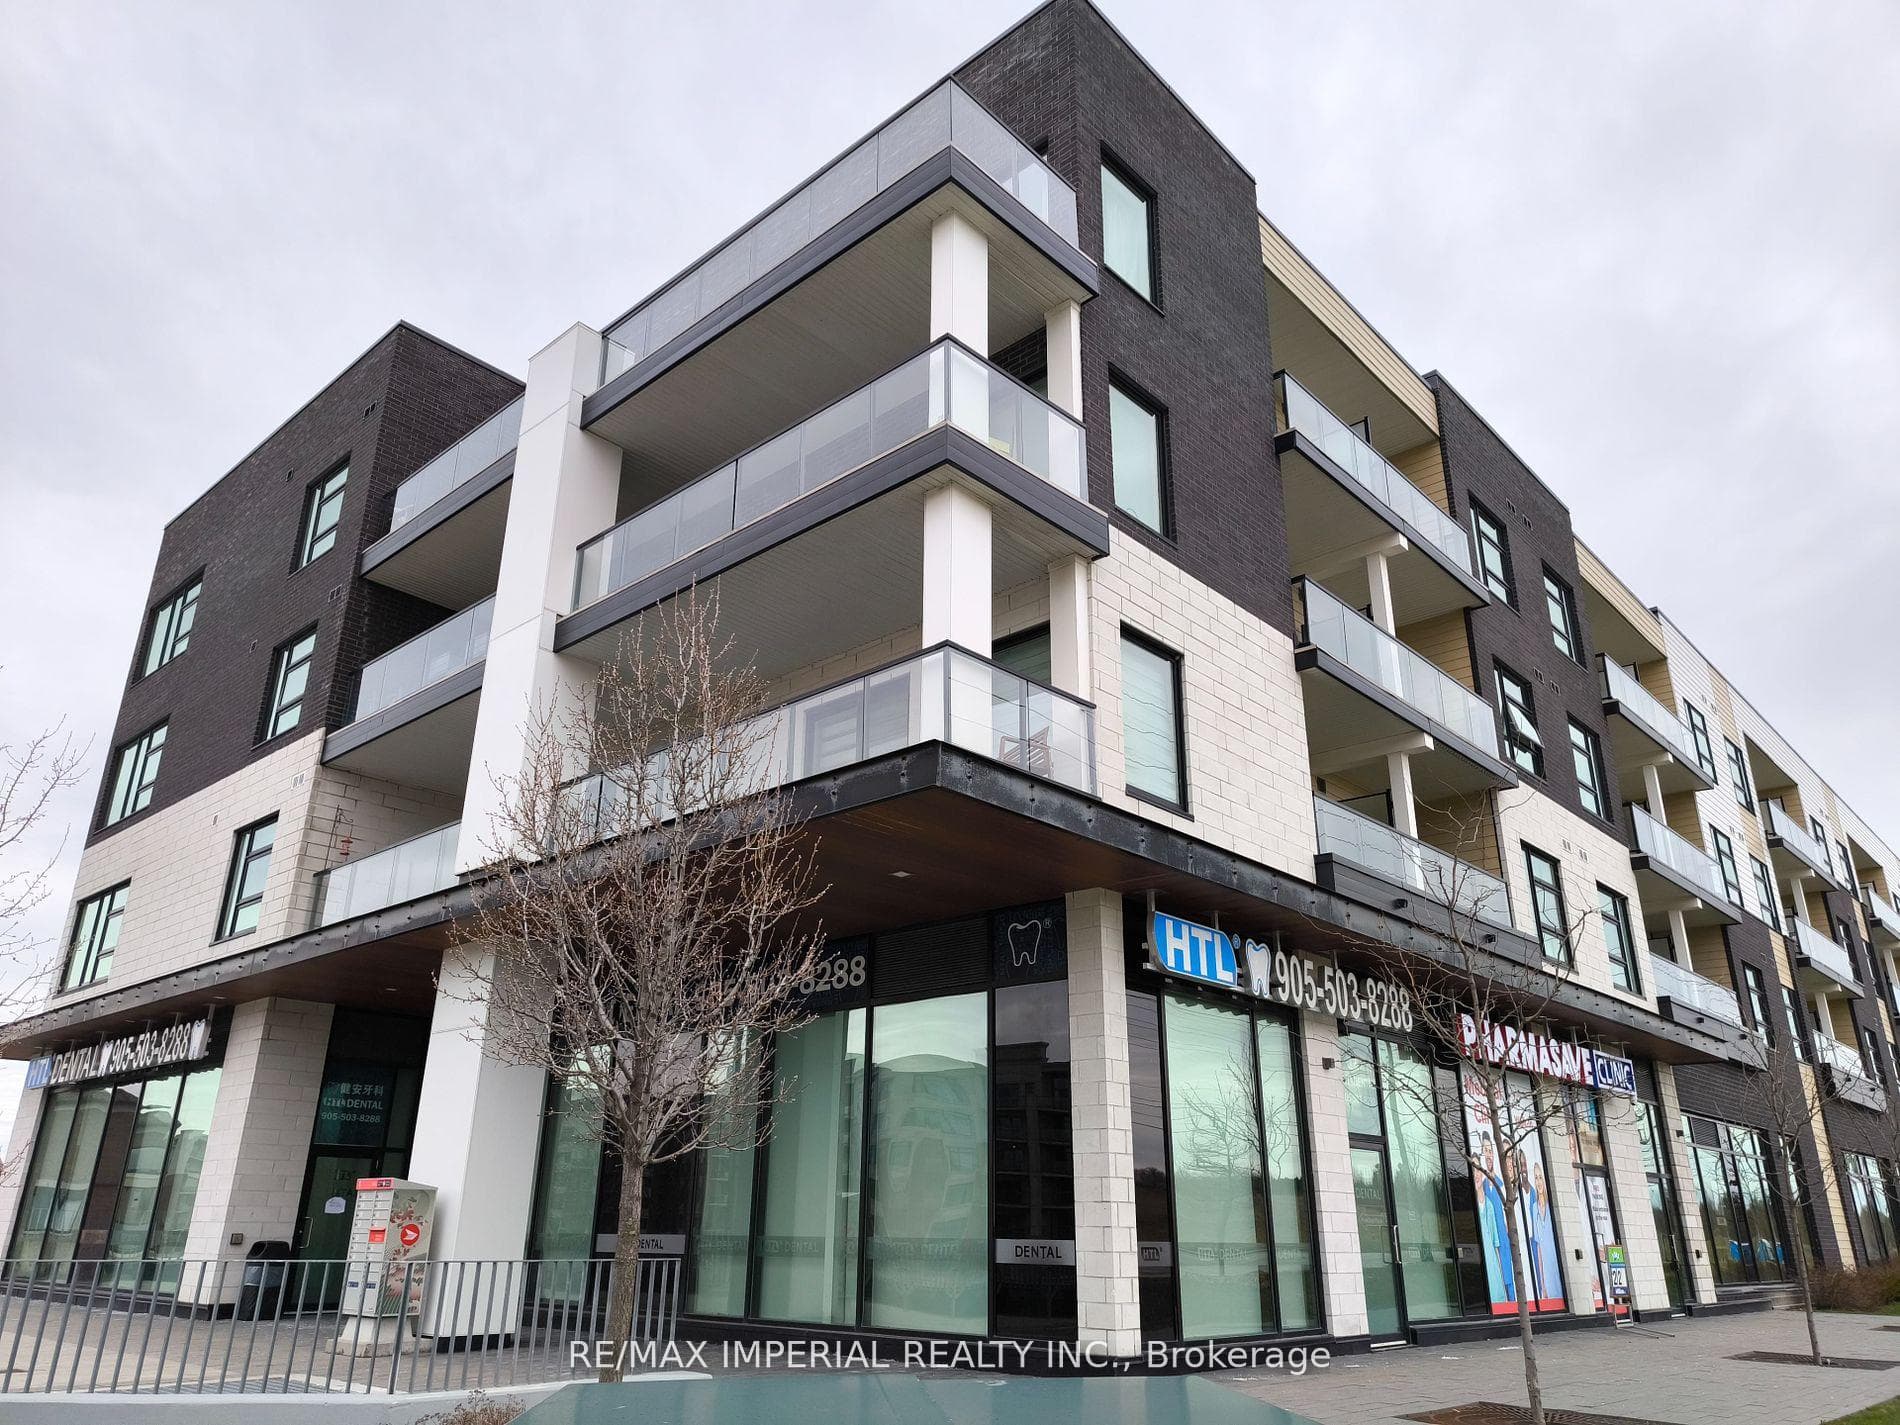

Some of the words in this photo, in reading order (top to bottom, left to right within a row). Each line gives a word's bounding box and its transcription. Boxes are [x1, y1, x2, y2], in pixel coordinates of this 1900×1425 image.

[1165, 919, 1234, 983] HTL
[1275, 951, 1413, 1033] 905-503-8288
[51, 1046, 99, 1083] DENTAL
[110, 1022, 192, 1073] 905-503-8288
[1461, 1013, 1594, 1086] PHARMASAVE
[1597, 1057, 1633, 1089] CLINIC
[347, 1099, 383, 1110] DENTAL
[1014, 1245, 1062, 1259] DENTAL
